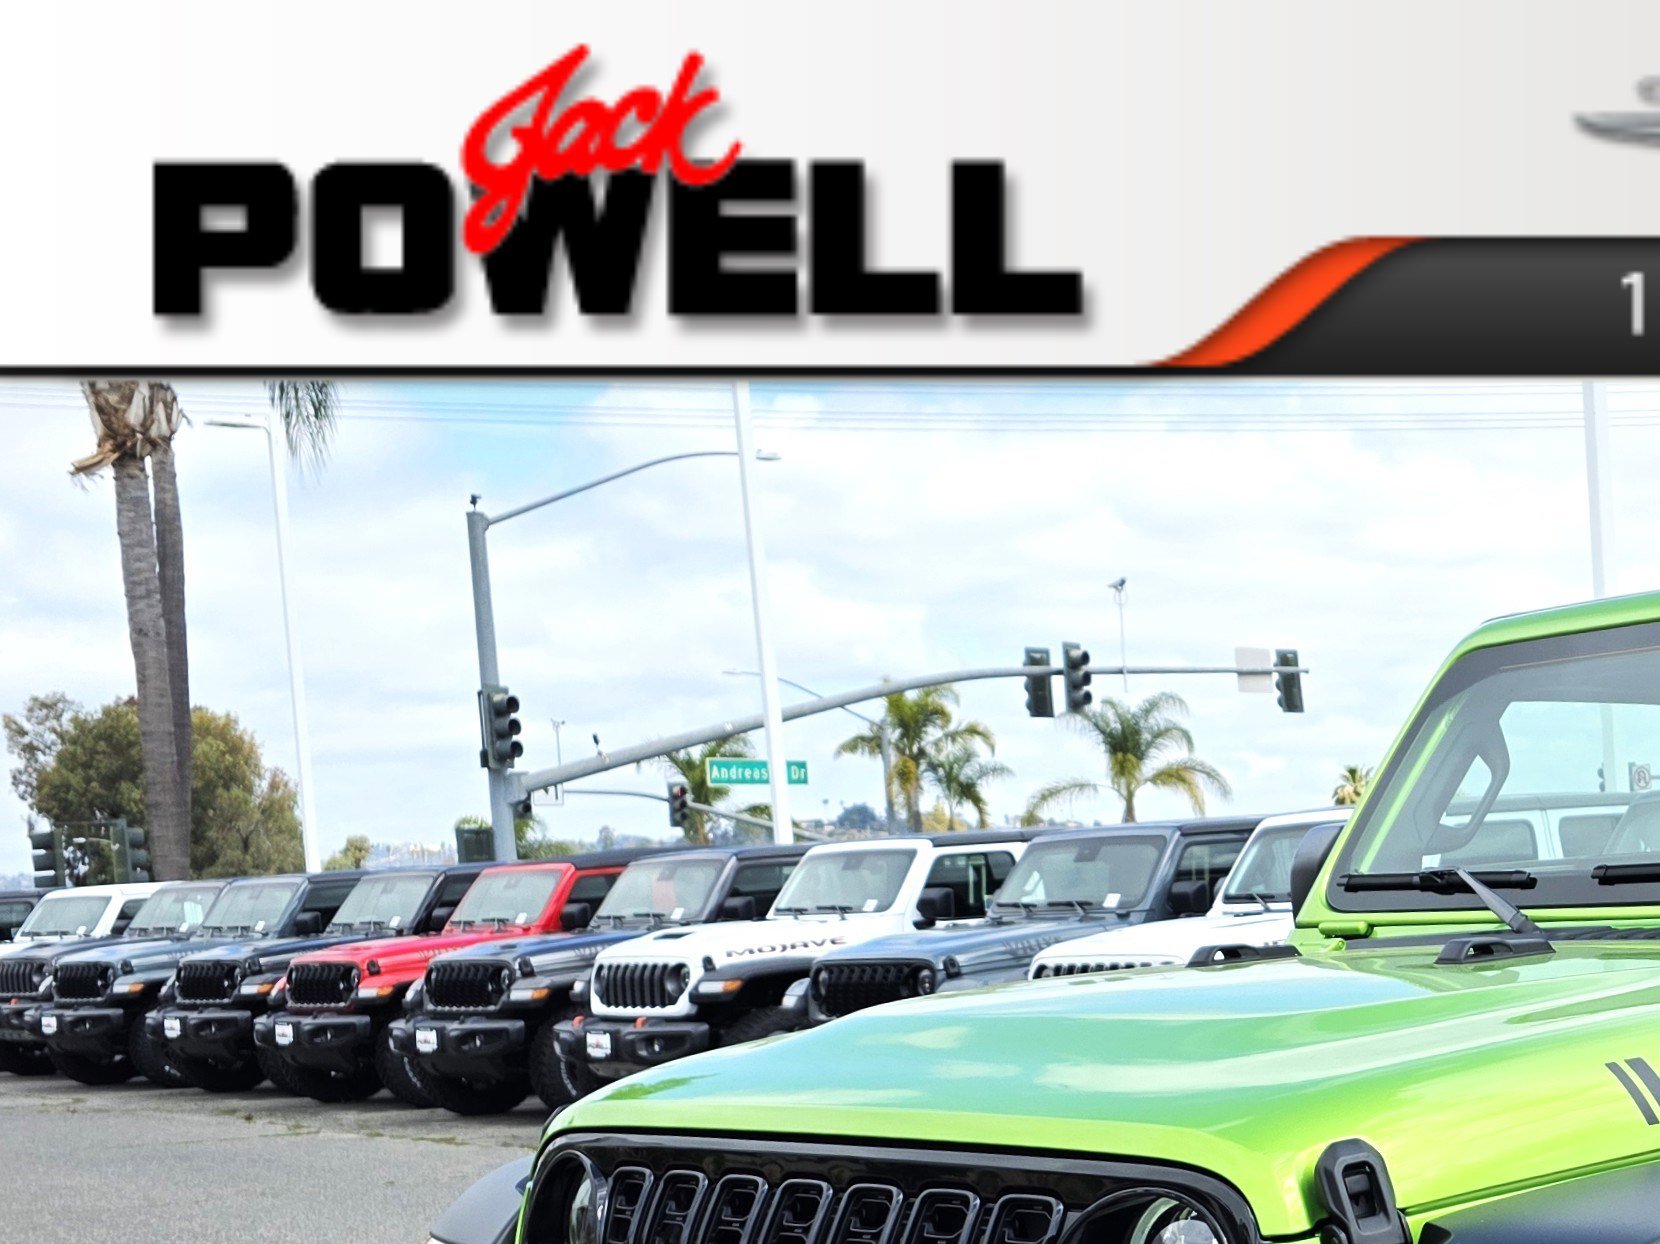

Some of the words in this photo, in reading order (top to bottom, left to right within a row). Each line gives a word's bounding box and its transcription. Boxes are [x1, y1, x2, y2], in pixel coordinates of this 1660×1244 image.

[711, 764, 769, 780] Andreas
[790, 765, 807, 780] Dr
[725, 935, 847, 957] MOJAVE
